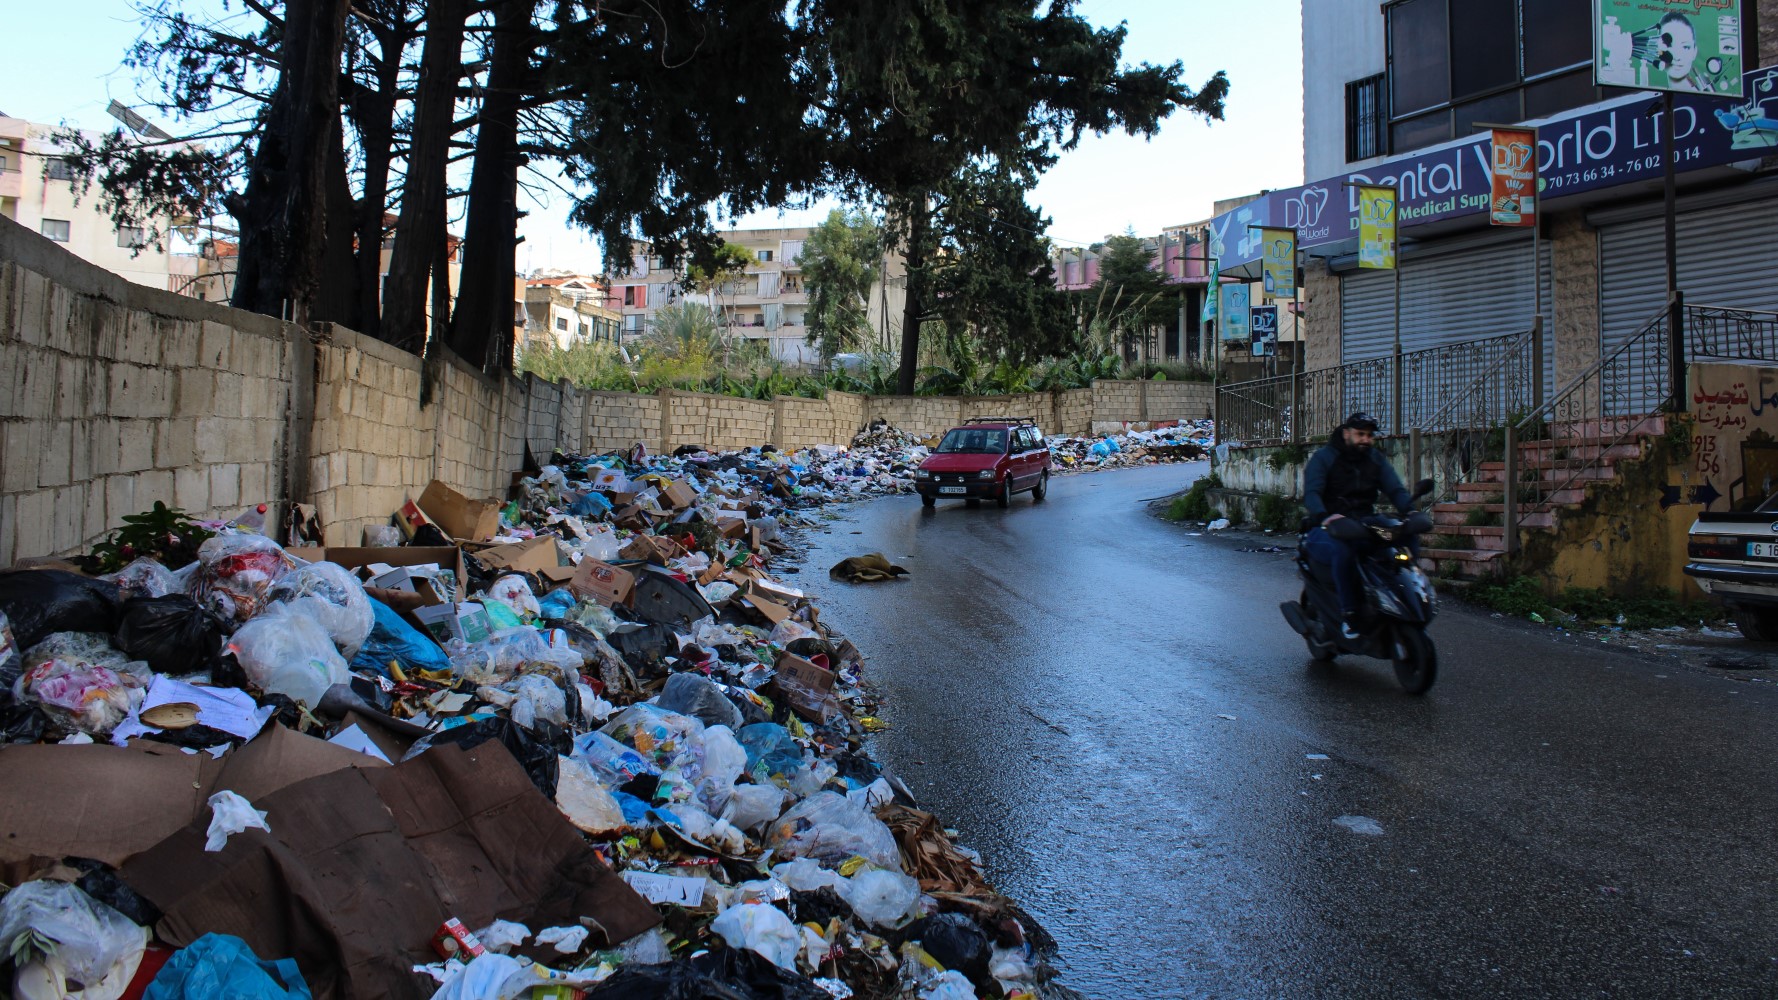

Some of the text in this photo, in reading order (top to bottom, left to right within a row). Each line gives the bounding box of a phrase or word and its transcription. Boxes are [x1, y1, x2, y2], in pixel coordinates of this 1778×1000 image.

[1549, 176, 1563, 189] 70
[1566, 172, 1580, 186] 73
[1583, 169, 1598, 182] 66
[1600, 164, 1615, 179] 34
[1626, 159, 1642, 173] 76
[1645, 154, 1660, 168] 02
[1684, 146, 1700, 161] 14
[1399, 196, 1455, 221] Medical
[1754, 543, 1761, 555] G
